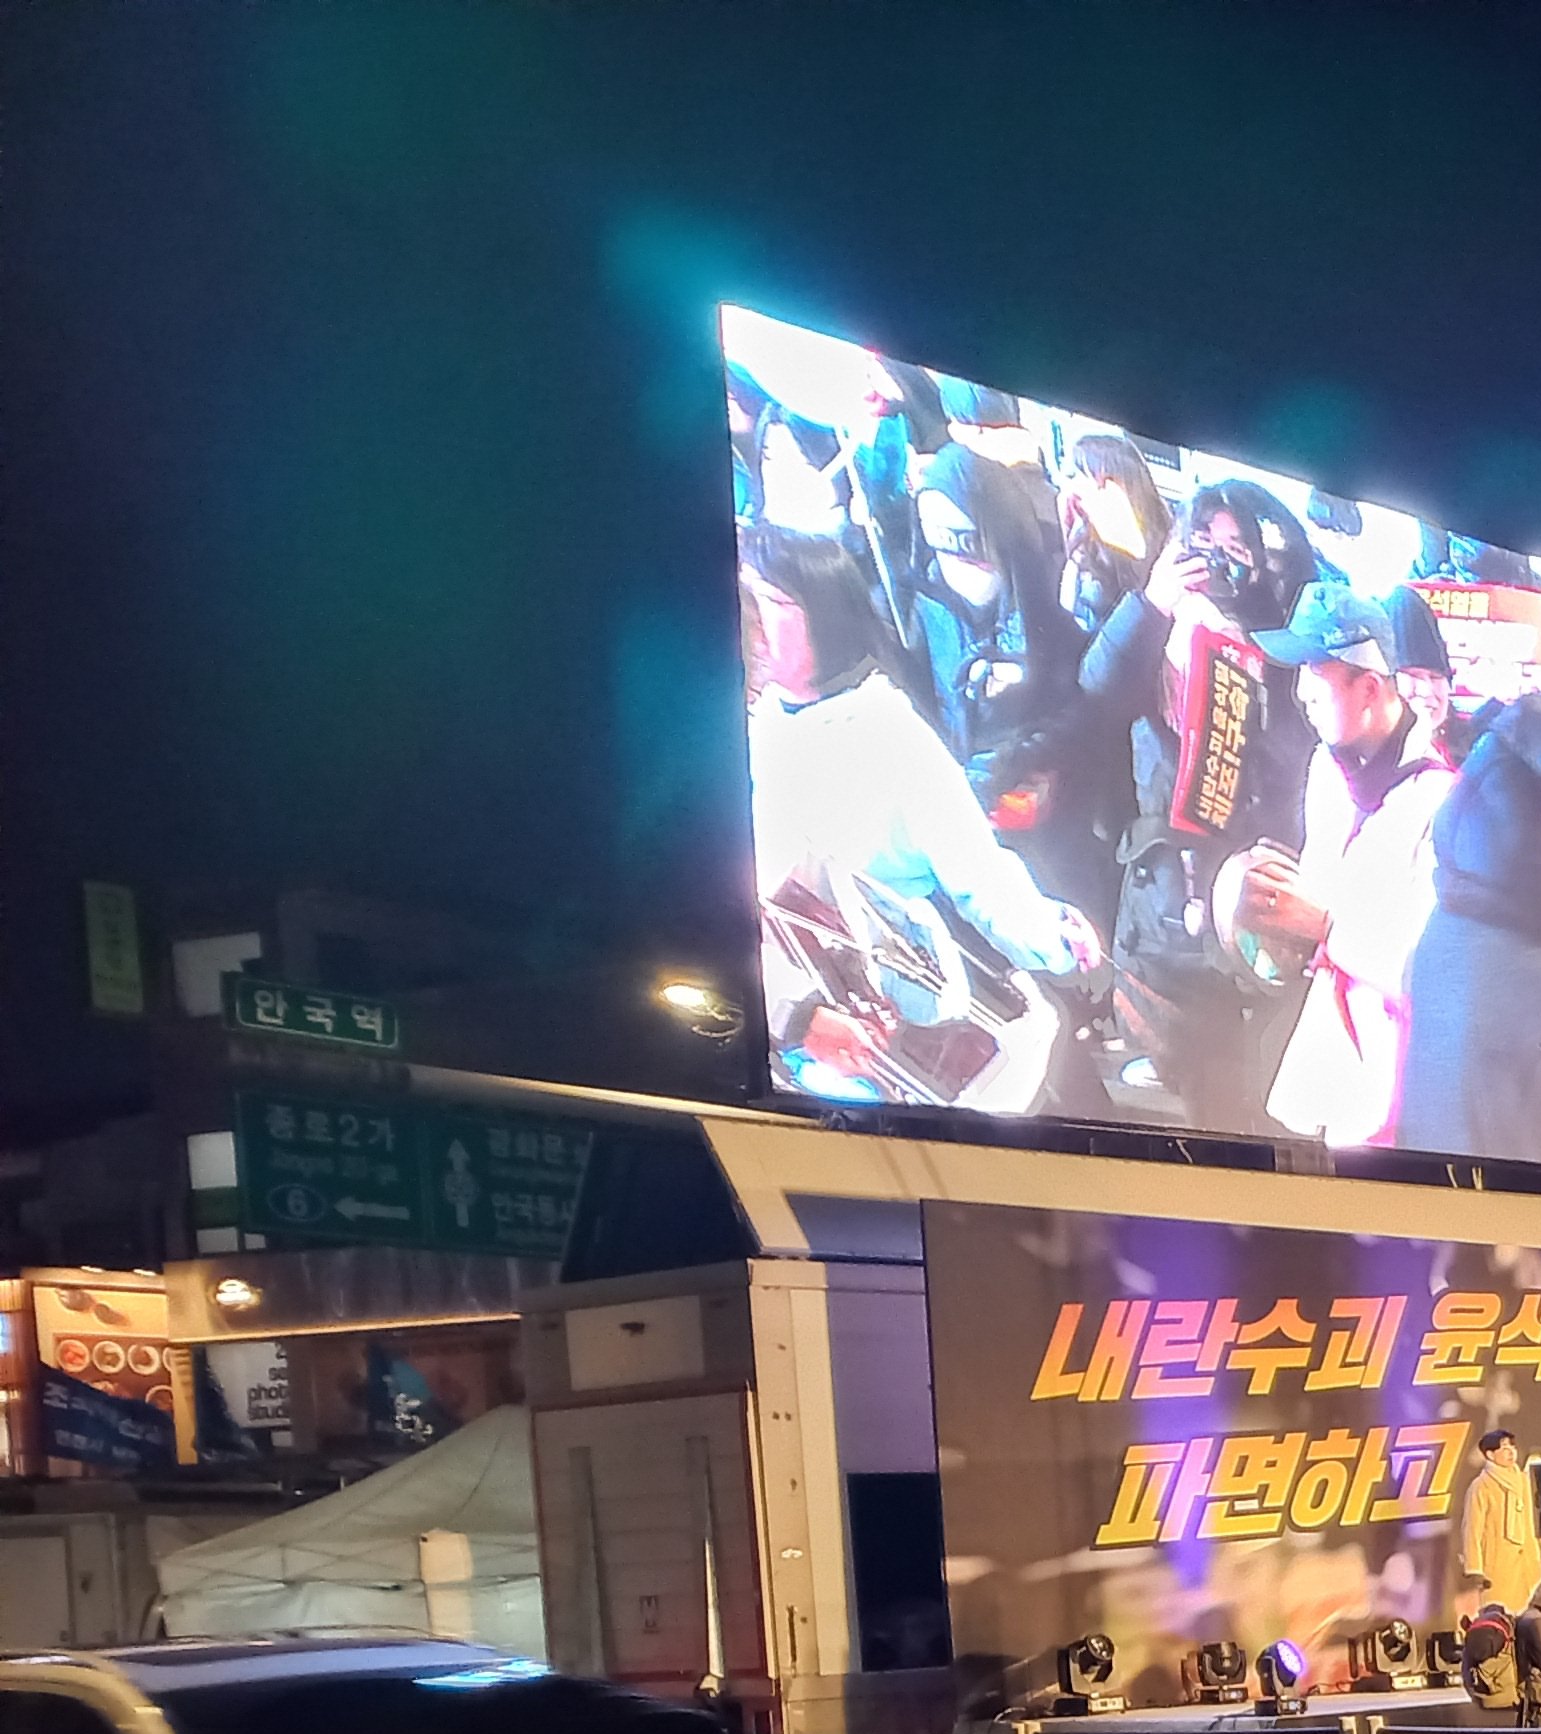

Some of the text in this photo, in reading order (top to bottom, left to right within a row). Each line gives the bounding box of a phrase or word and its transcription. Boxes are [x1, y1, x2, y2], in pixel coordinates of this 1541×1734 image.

[254, 989, 383, 1042] 안국역
[1030, 1297, 1407, 1402] 내란수괴
[1095, 1421, 1471, 1546] 파면하고
